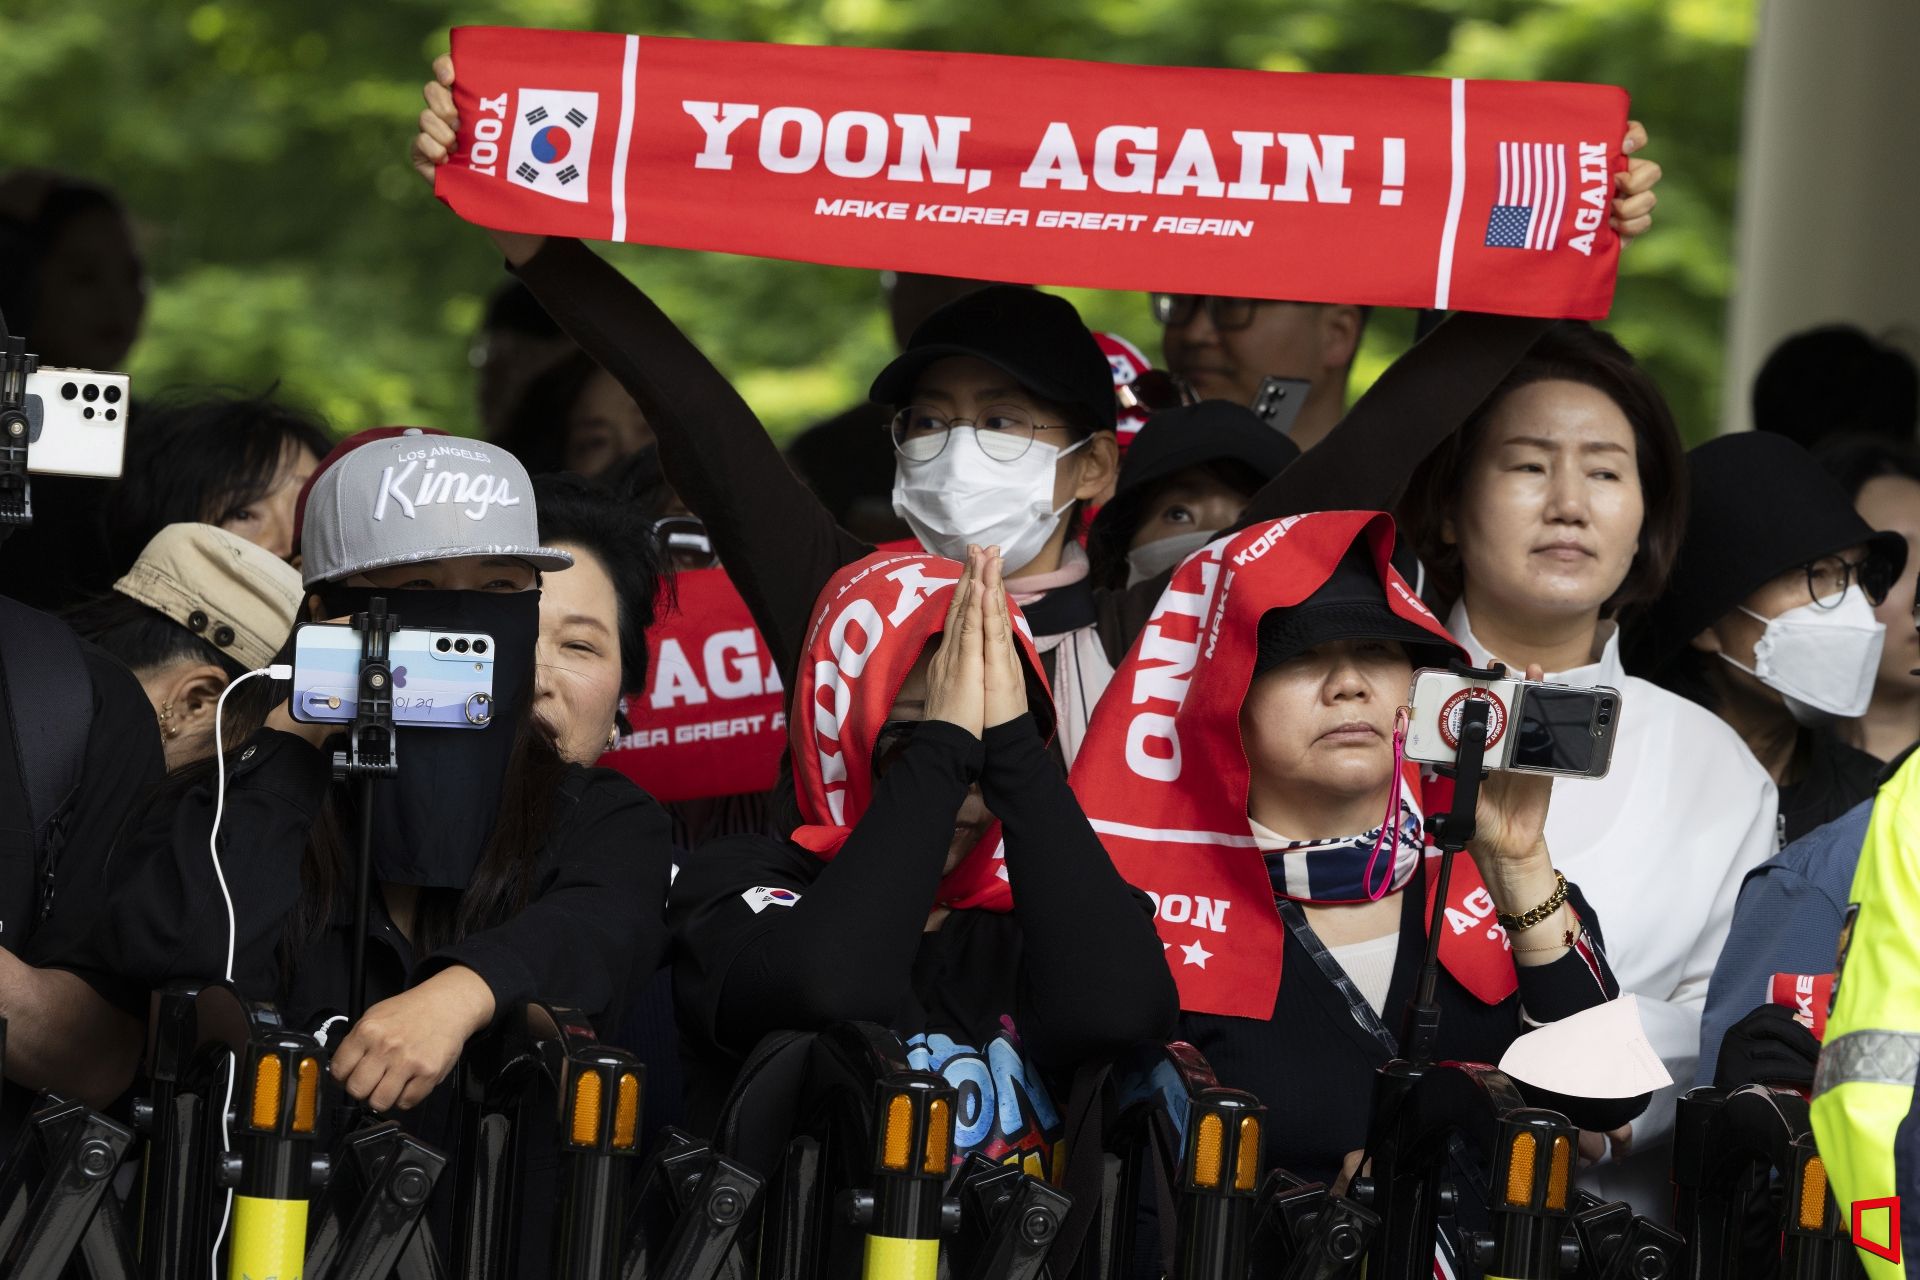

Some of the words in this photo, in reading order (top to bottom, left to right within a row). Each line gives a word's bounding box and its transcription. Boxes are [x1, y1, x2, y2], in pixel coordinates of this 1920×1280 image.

[682, 100, 992, 193] YOON,
[1020, 122, 1355, 204] AGAIN
[815, 198, 909, 222] MAKE
[915, 204, 1029, 227] KOREA
[1036, 210, 1148, 232] GREAT
[1152, 216, 1254, 238] AGAIN
[1568, 142, 1608, 257] AGAIN
[398, 449, 427, 463] LOS
[430, 446, 491, 464] ANGELES
[373, 458, 520, 521] Kings
[1204, 568, 1236, 660] MAKE
[1232, 513, 1308, 566] KORE
[391, 696, 410, 714] lo
[415, 698, 434, 716] be
[675, 714, 766, 744] GREAT
[1443, 886, 1496, 936] AG
